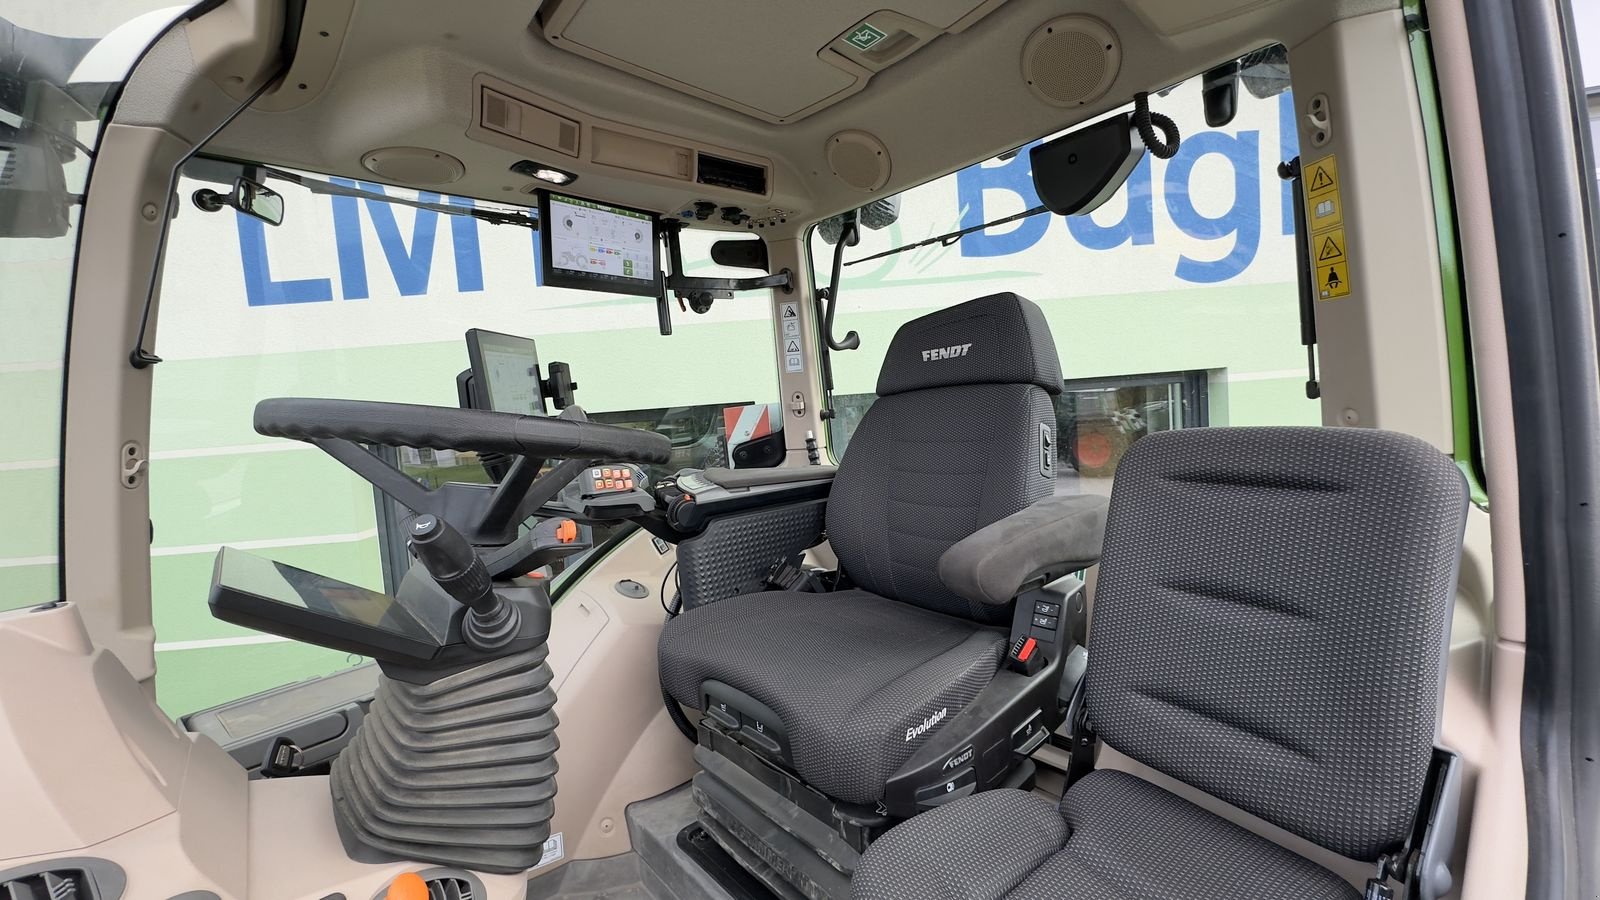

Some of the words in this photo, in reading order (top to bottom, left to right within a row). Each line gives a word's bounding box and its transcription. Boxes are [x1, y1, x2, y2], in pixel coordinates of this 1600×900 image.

[921, 343, 972, 361] FENDT
[906, 708, 947, 742] Evolution
[948, 749, 973, 768] FENDT
